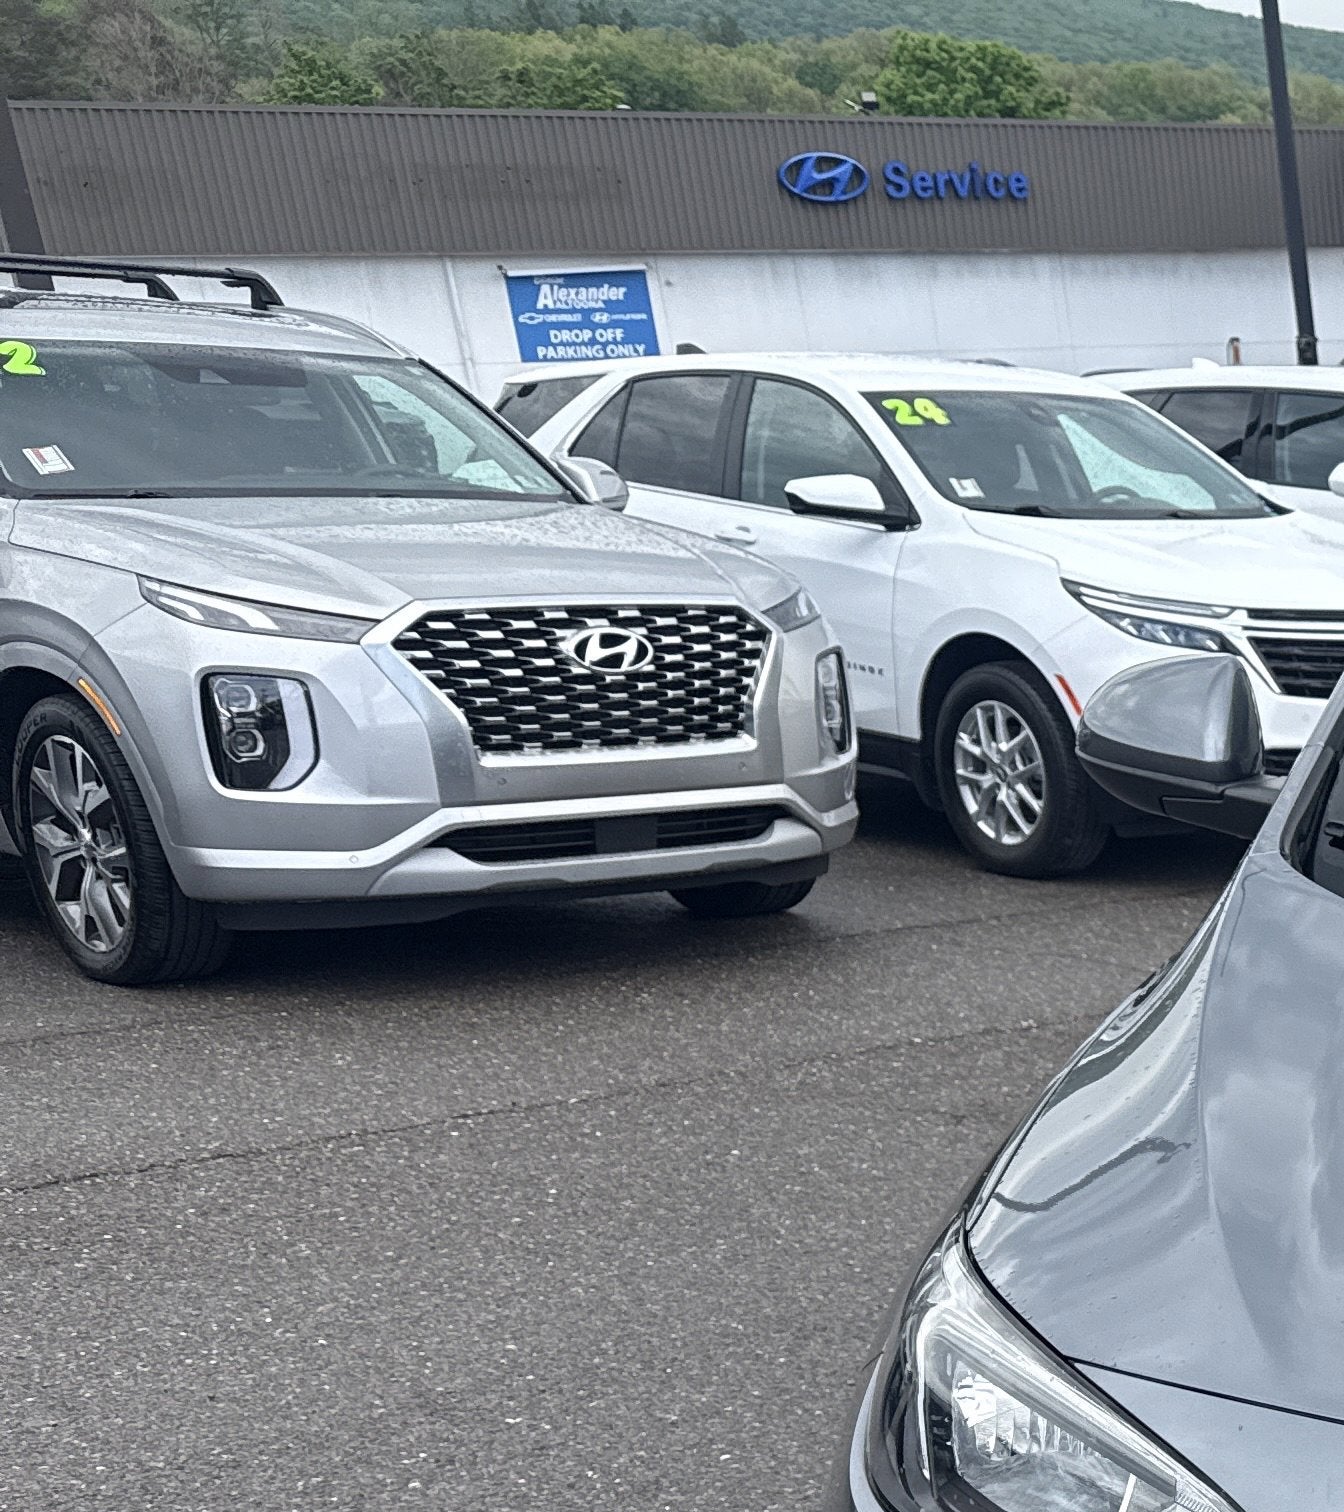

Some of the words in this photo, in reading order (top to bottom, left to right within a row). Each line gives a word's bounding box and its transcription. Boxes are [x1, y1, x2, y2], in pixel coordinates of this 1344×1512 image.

[883, 160, 1030, 200] Service
[536, 283, 628, 309] Alexander
[550, 329, 593, 343] DROP
[595, 328, 625, 343] OFF
[536, 345, 605, 360] PARKING
[606, 343, 646, 357] ONLY
[881, 397, 952, 426] 24
